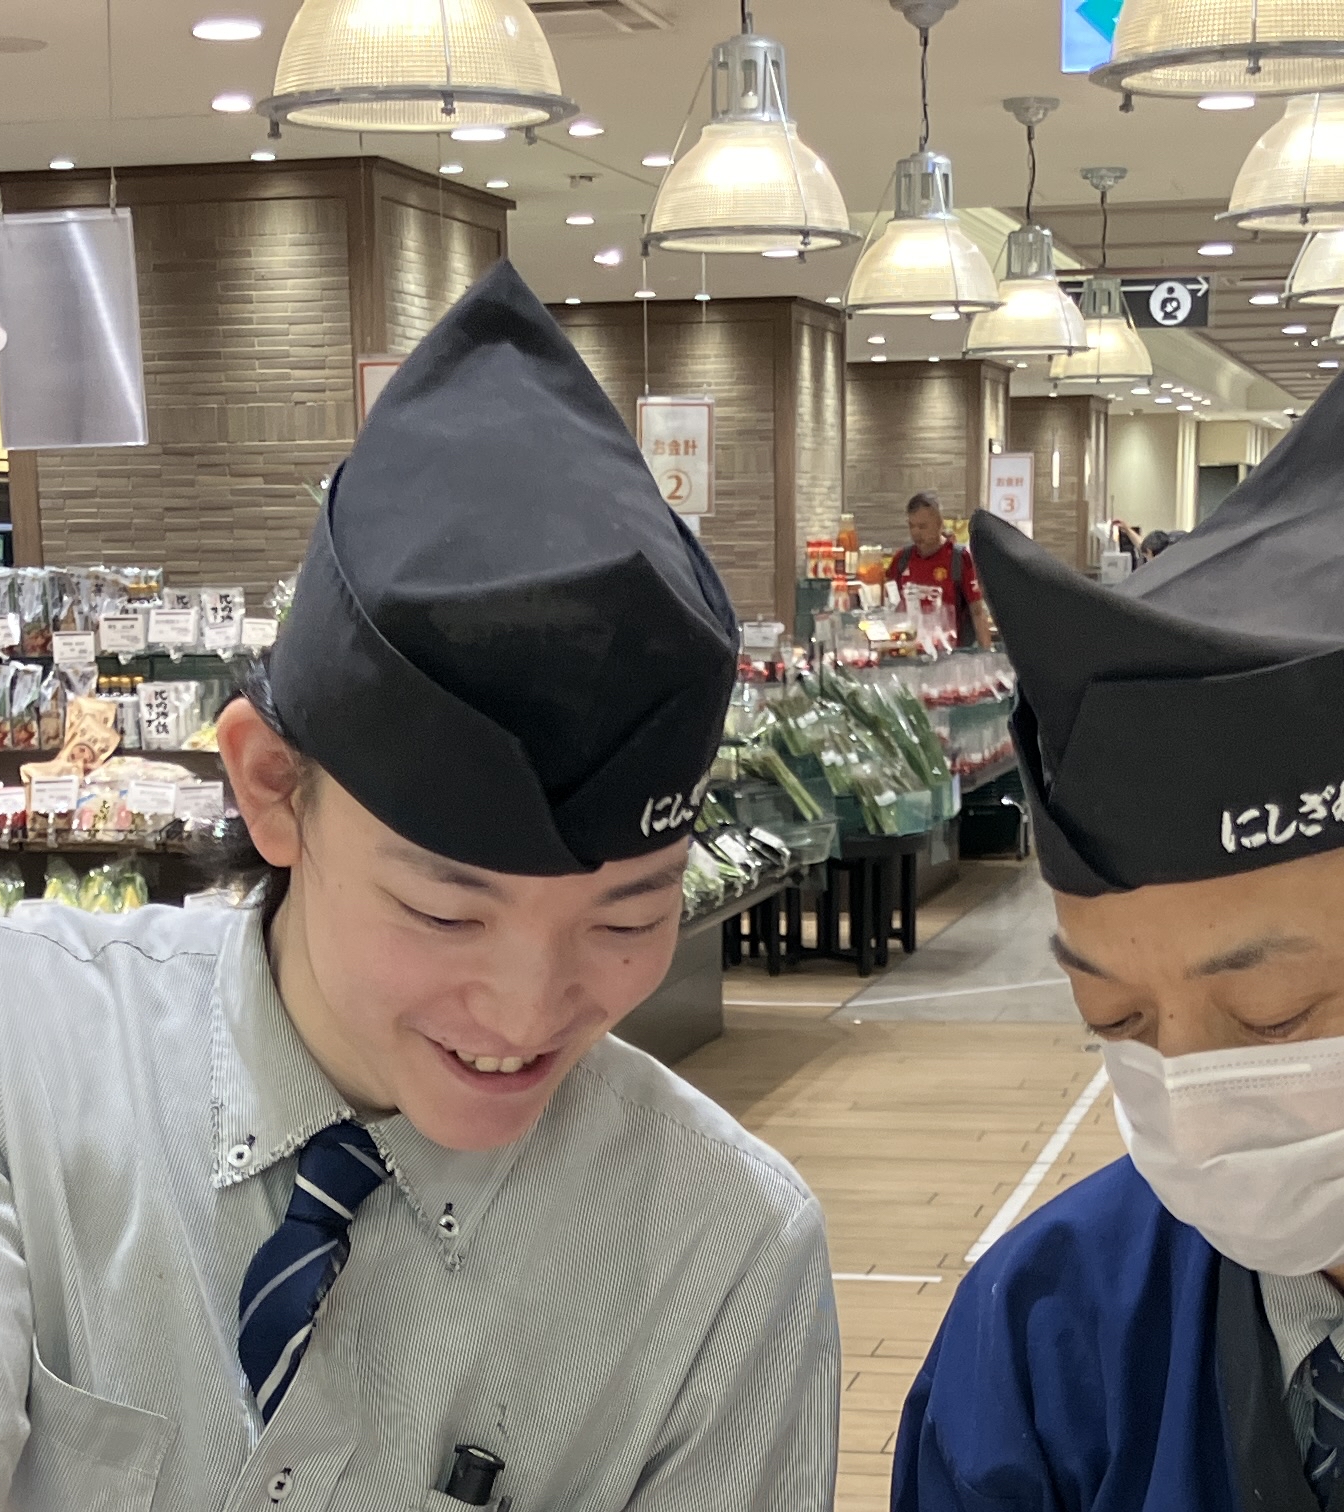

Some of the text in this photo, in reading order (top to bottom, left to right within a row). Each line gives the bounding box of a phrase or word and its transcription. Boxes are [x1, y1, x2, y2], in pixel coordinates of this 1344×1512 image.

[652, 438, 698, 456] お会計
[666, 474, 684, 501] 2
